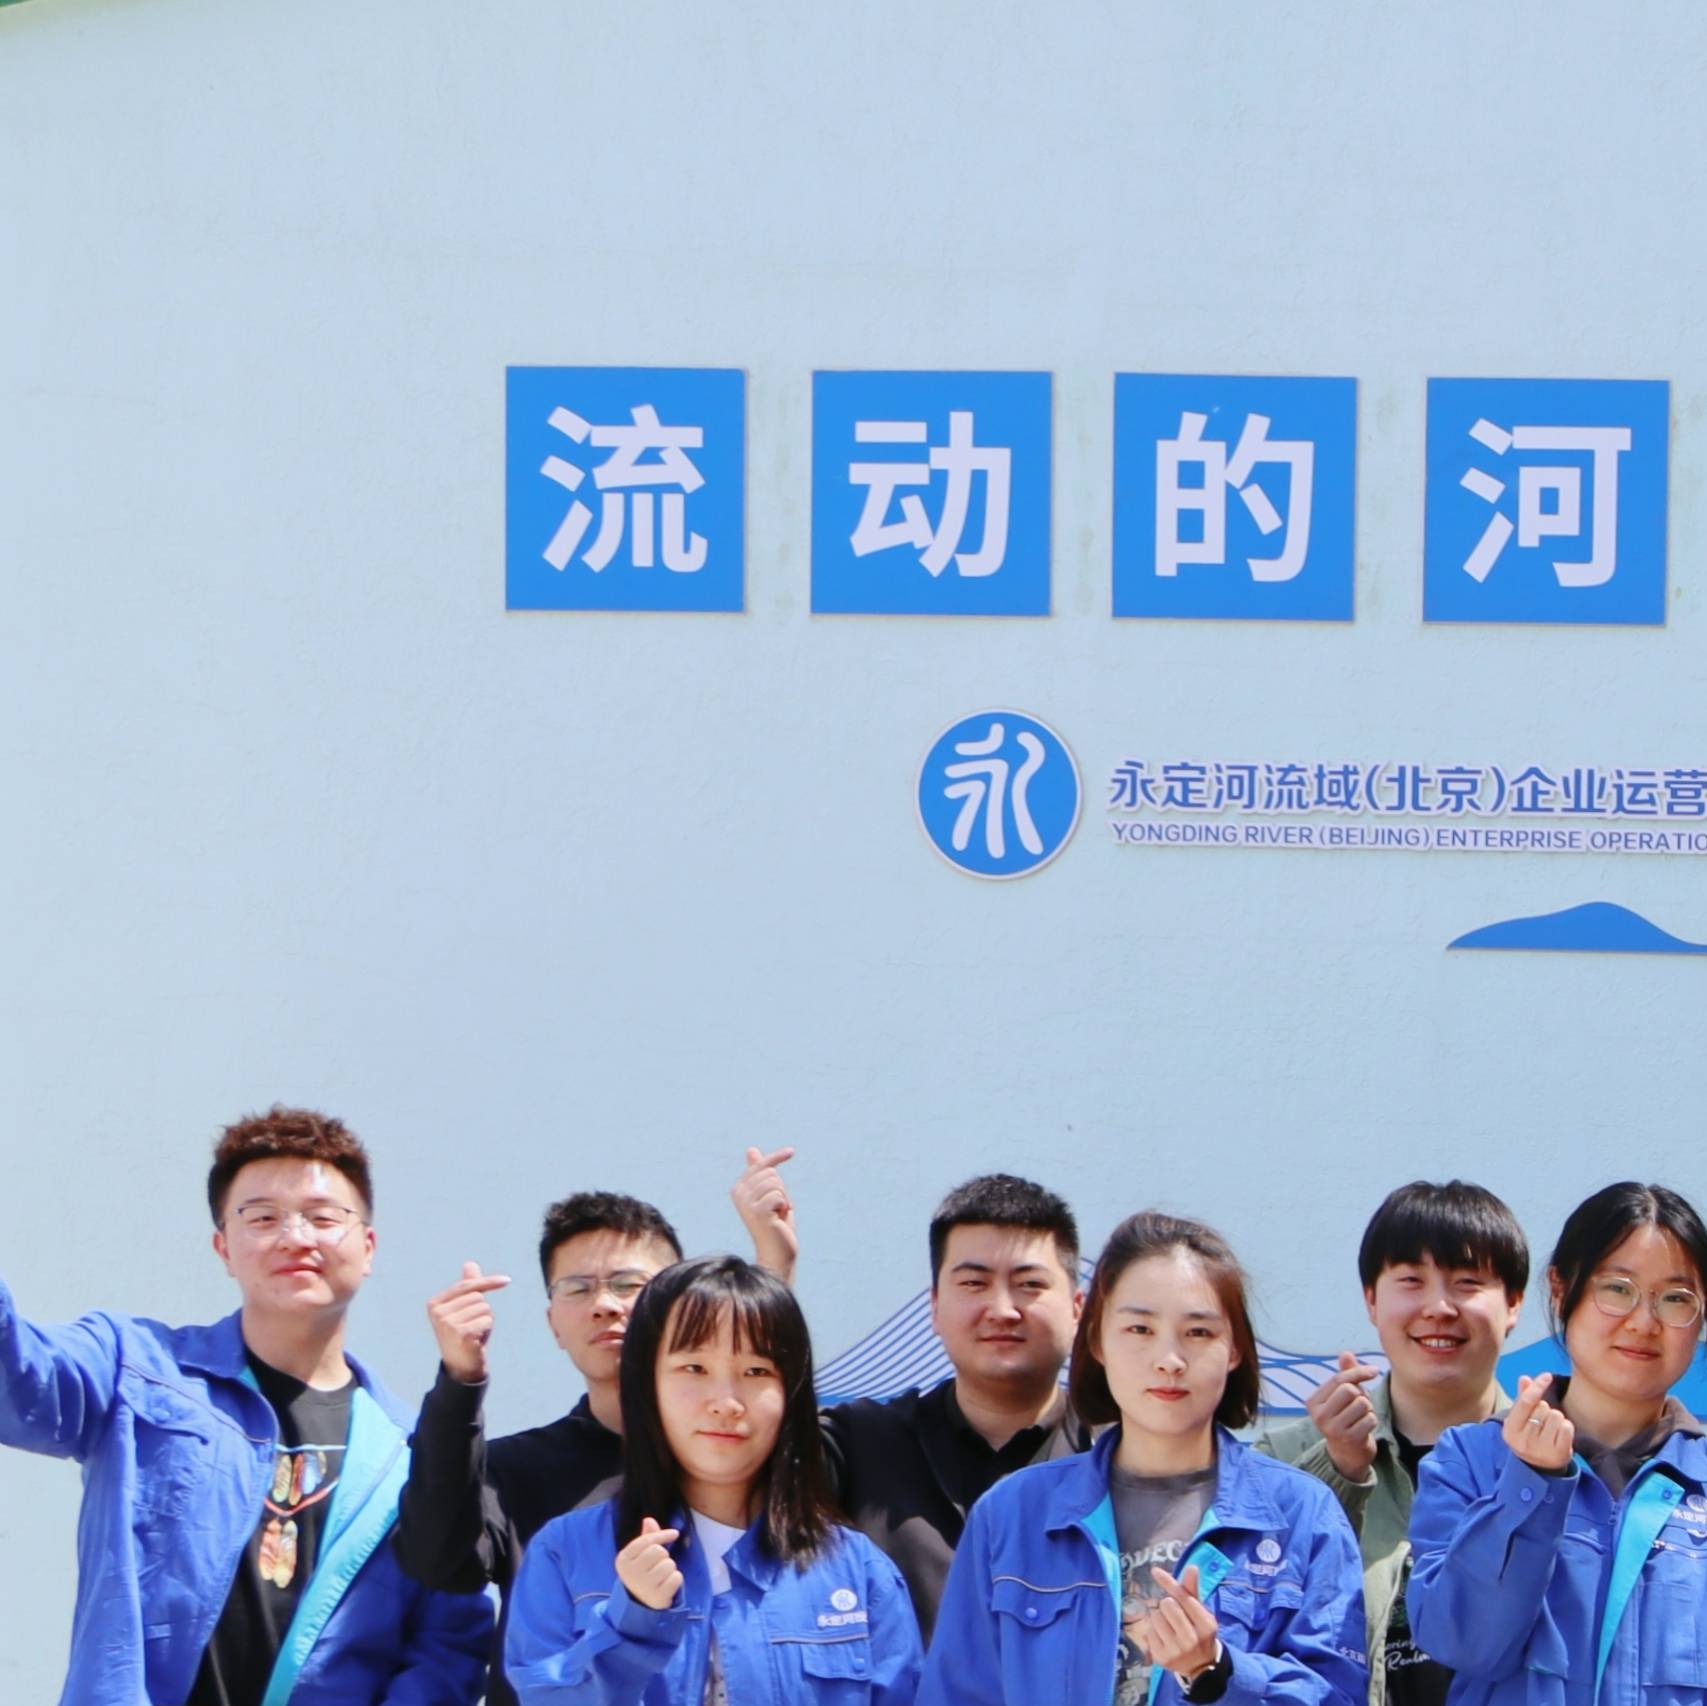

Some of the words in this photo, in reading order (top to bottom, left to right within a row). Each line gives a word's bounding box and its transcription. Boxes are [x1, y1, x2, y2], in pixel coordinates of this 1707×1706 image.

[1113, 823, 1238, 843] YONGDING
[1244, 826, 1313, 844] RIVER
[1318, 827, 1430, 847] (BEIJING)
[1436, 829, 1582, 849] ENTERPRISE
